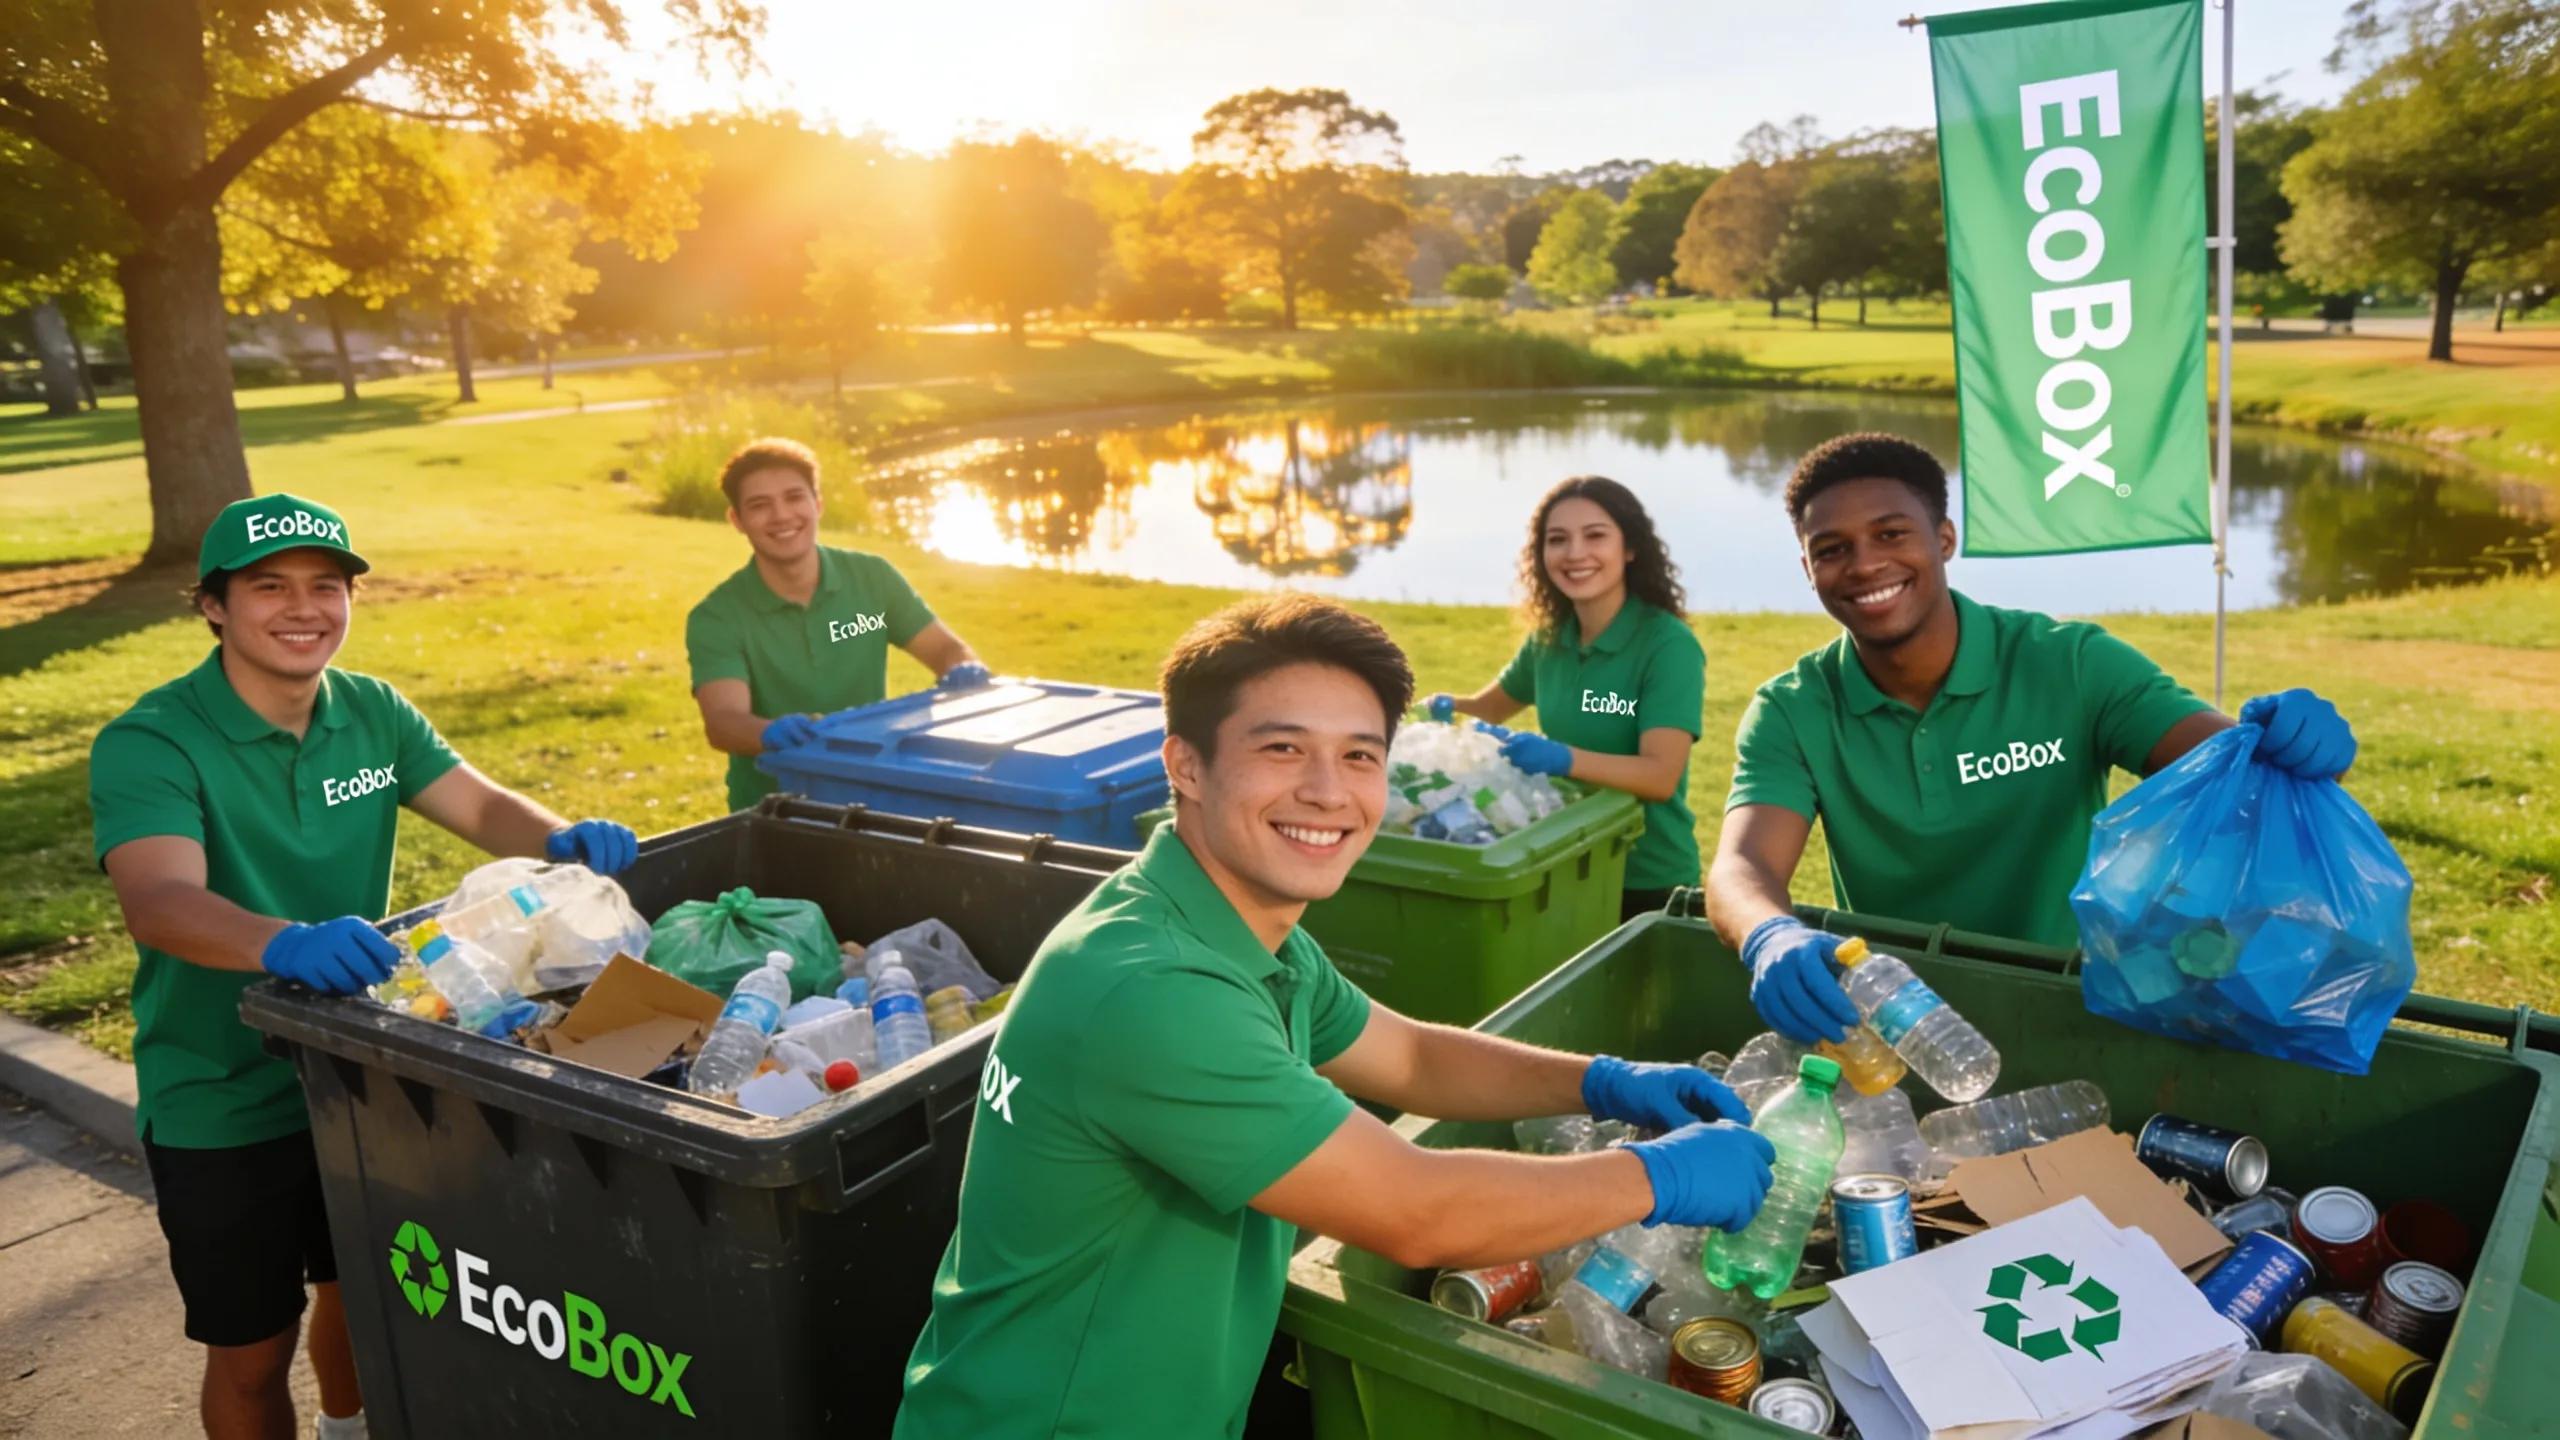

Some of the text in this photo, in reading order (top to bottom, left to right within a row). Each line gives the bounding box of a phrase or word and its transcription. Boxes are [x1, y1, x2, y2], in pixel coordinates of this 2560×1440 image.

[2019, 69, 2132, 501] EcoBox
[246, 510, 343, 544] EcoBox
[828, 611, 888, 643] EcoBox
[1956, 738, 2066, 785] EcoBox
[322, 763, 398, 807] EcoBox
[455, 1248, 696, 1419] EcoBox
